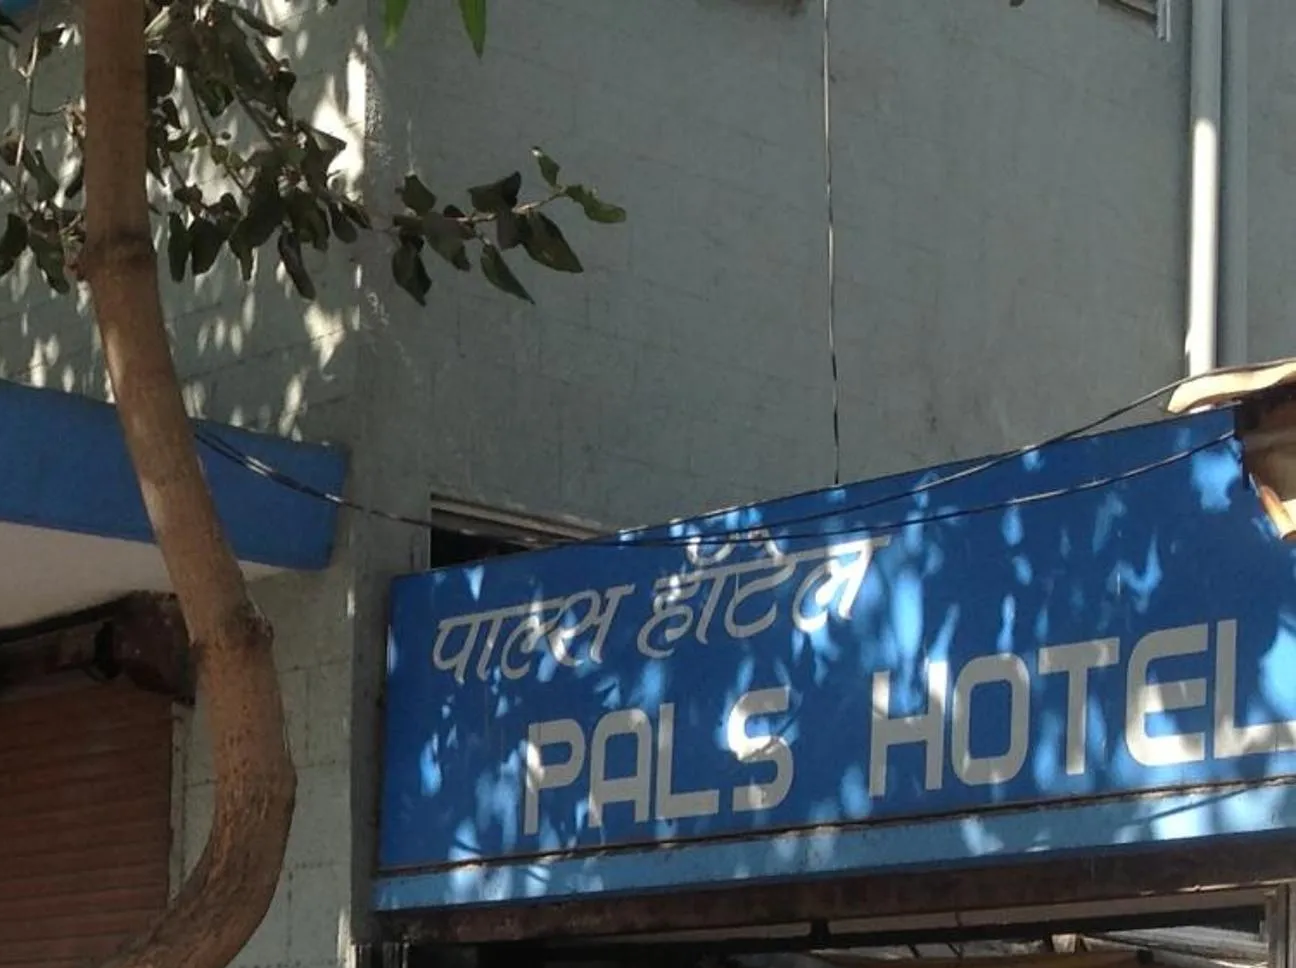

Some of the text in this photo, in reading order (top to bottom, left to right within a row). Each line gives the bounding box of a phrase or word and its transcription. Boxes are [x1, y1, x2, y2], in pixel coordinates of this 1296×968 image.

[432, 583, 635, 684] पाल्स
[524, 618, 1296, 835] PALS HOTEL
